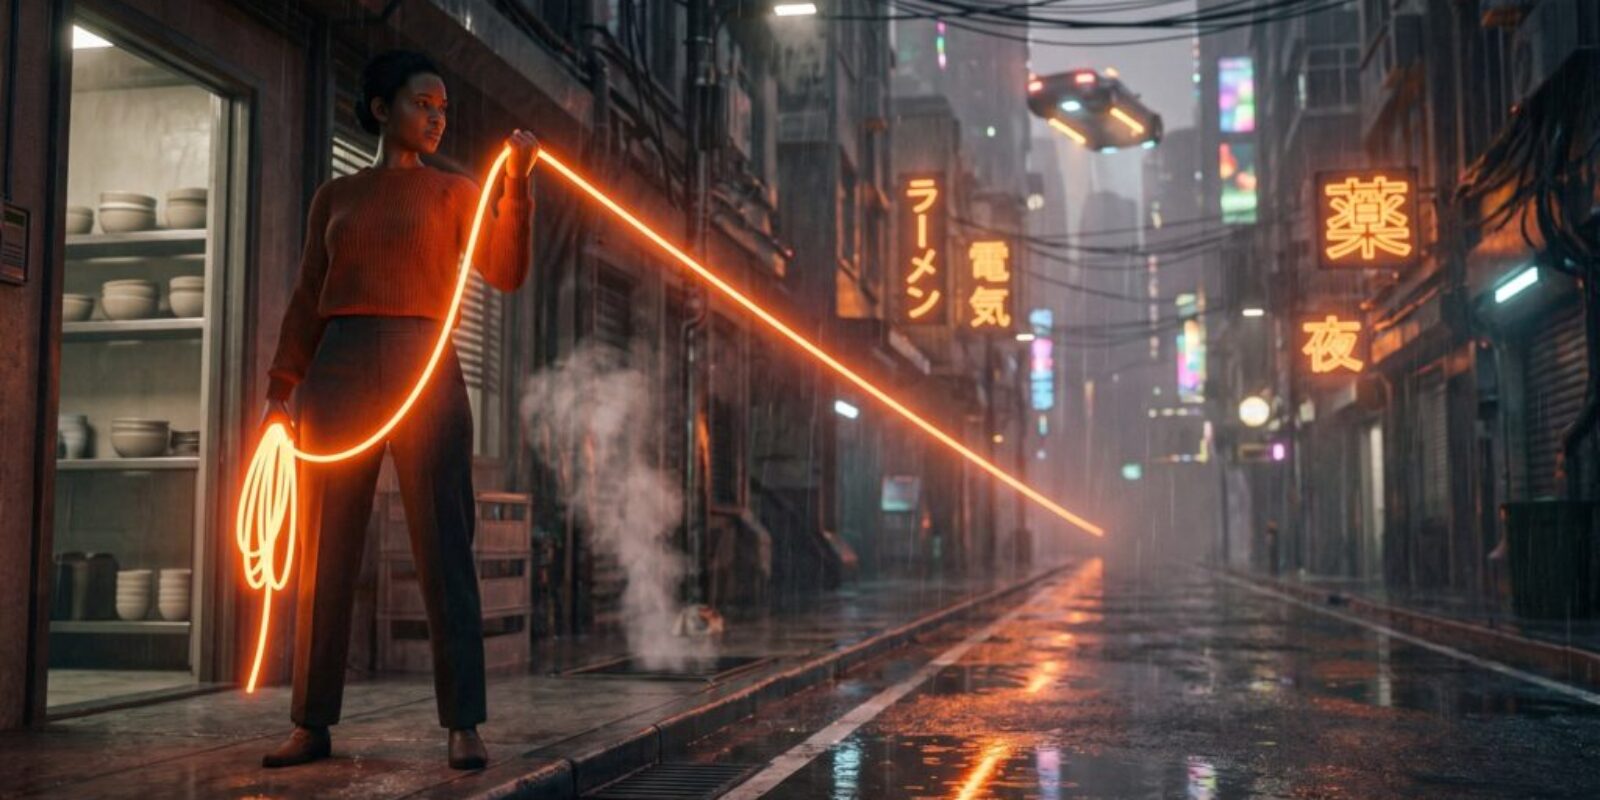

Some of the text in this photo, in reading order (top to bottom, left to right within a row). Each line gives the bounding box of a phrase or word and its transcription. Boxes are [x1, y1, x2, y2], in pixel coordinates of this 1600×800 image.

[906, 179, 940, 319] ラーメン
[1325, 176, 1411, 260] 薬
[969, 241, 1011, 327] 電気
[1302, 315, 1364, 373] 夜
